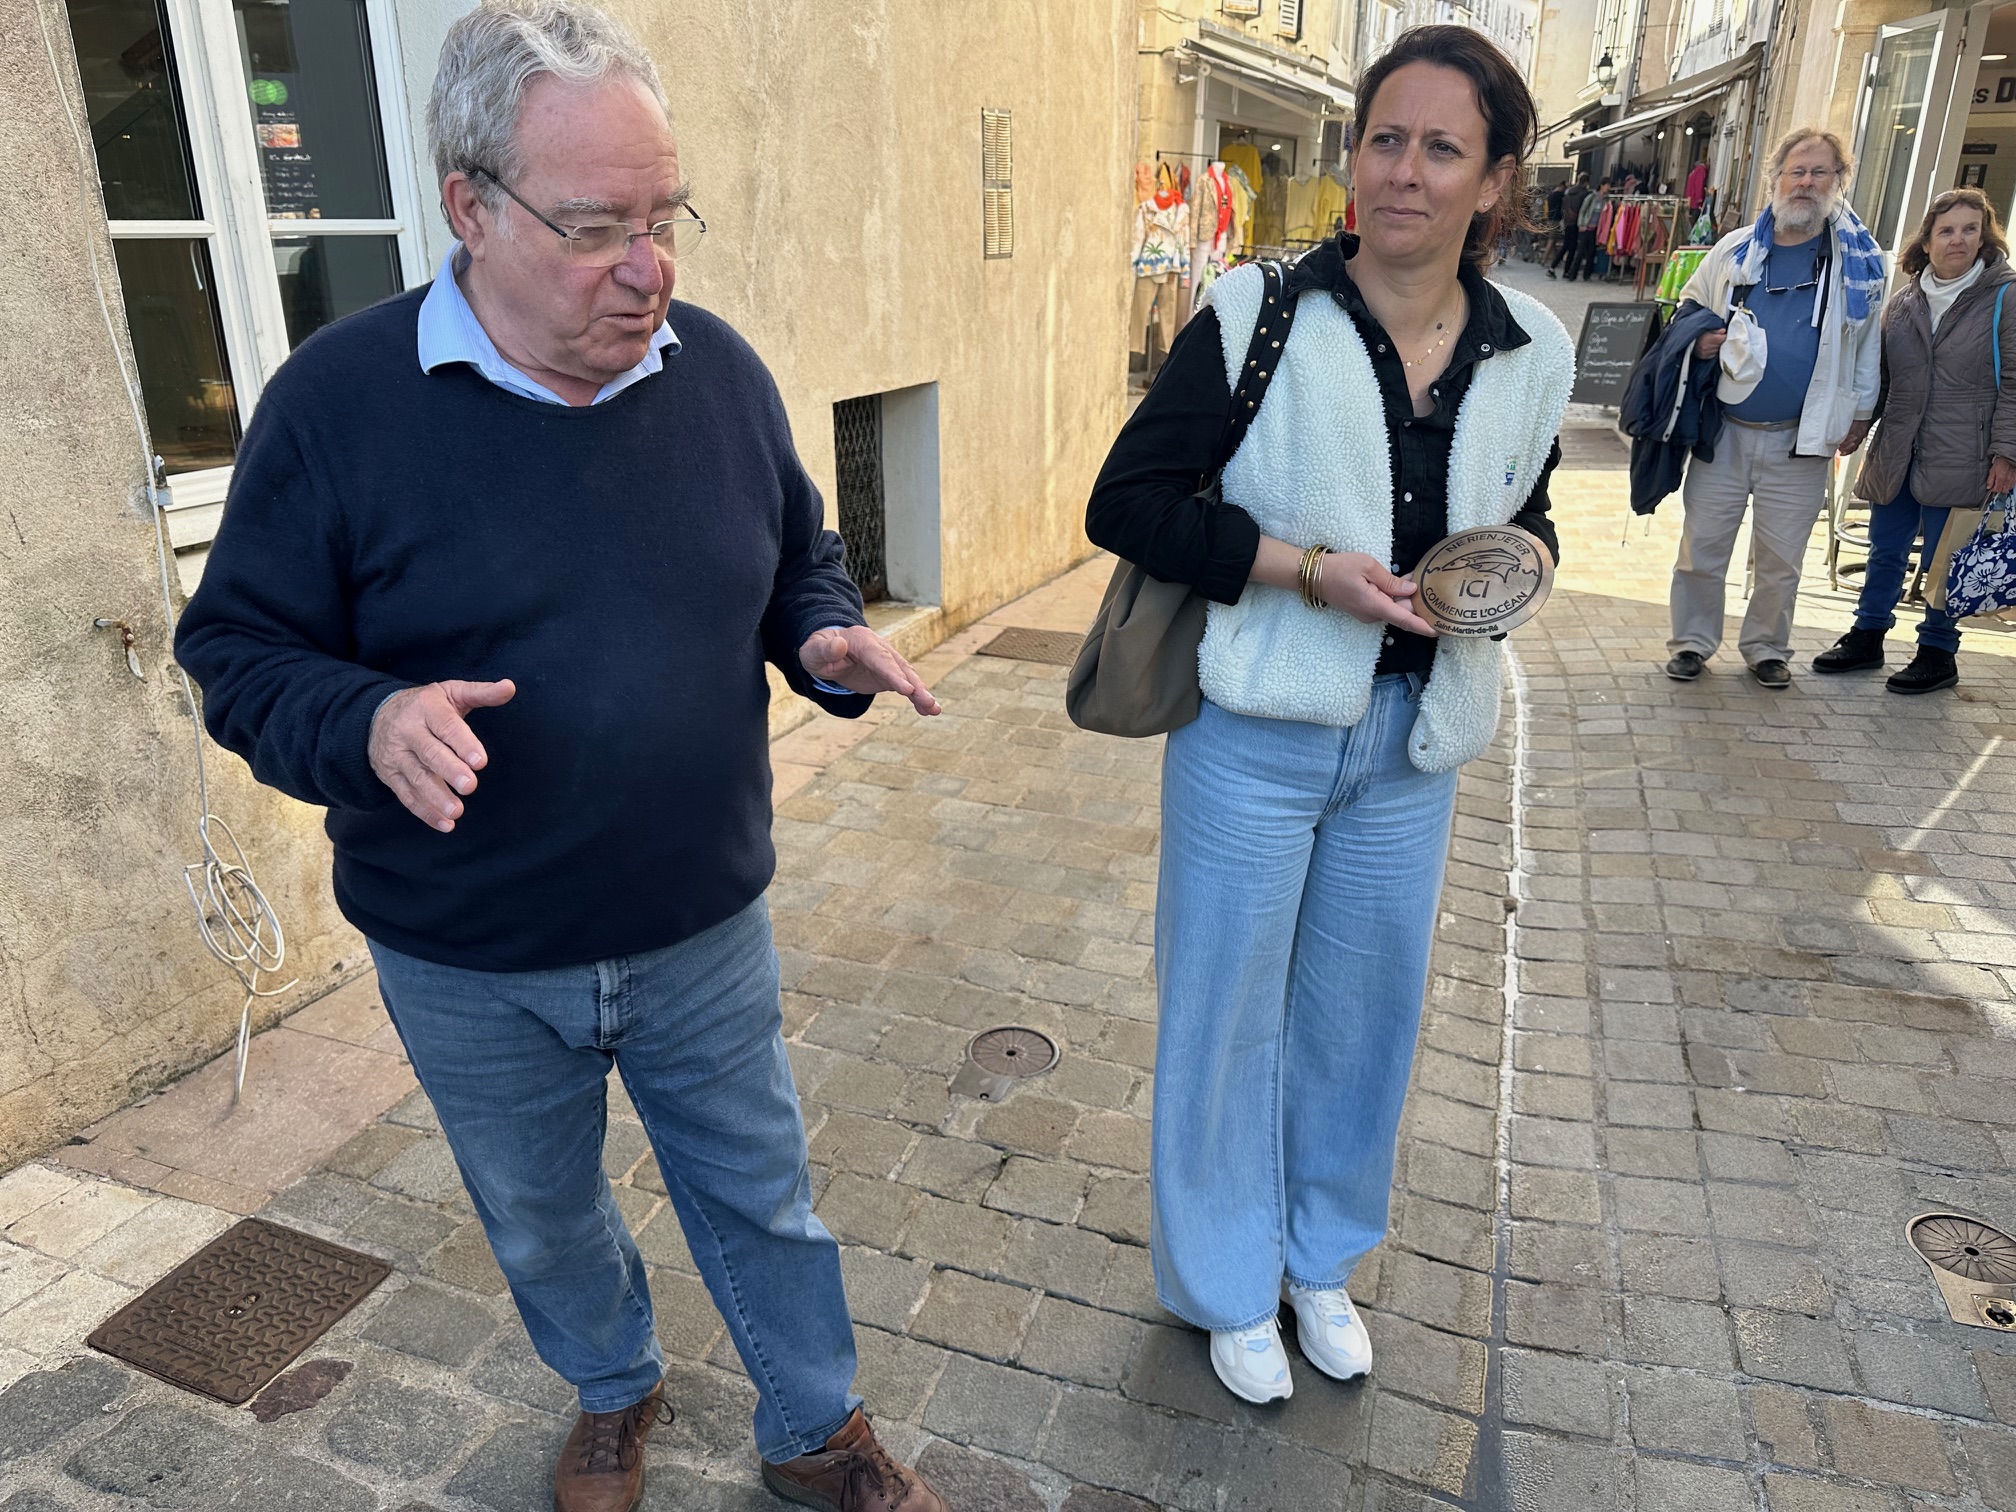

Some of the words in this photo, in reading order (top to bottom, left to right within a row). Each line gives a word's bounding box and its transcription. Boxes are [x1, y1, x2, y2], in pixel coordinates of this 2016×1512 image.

[1971, 88, 1990, 104] S
[1446, 540, 1465, 553] NE
[1467, 533, 1498, 544] RIEN
[1497, 533, 1531, 556] JETER
[1458, 579, 1490, 599] ICI
[1425, 587, 1478, 619] COMMENCE
[1480, 591, 1528, 618] L'OCÉAN
[1434, 620, 1499, 635] Saint-Martin-de-Ré
